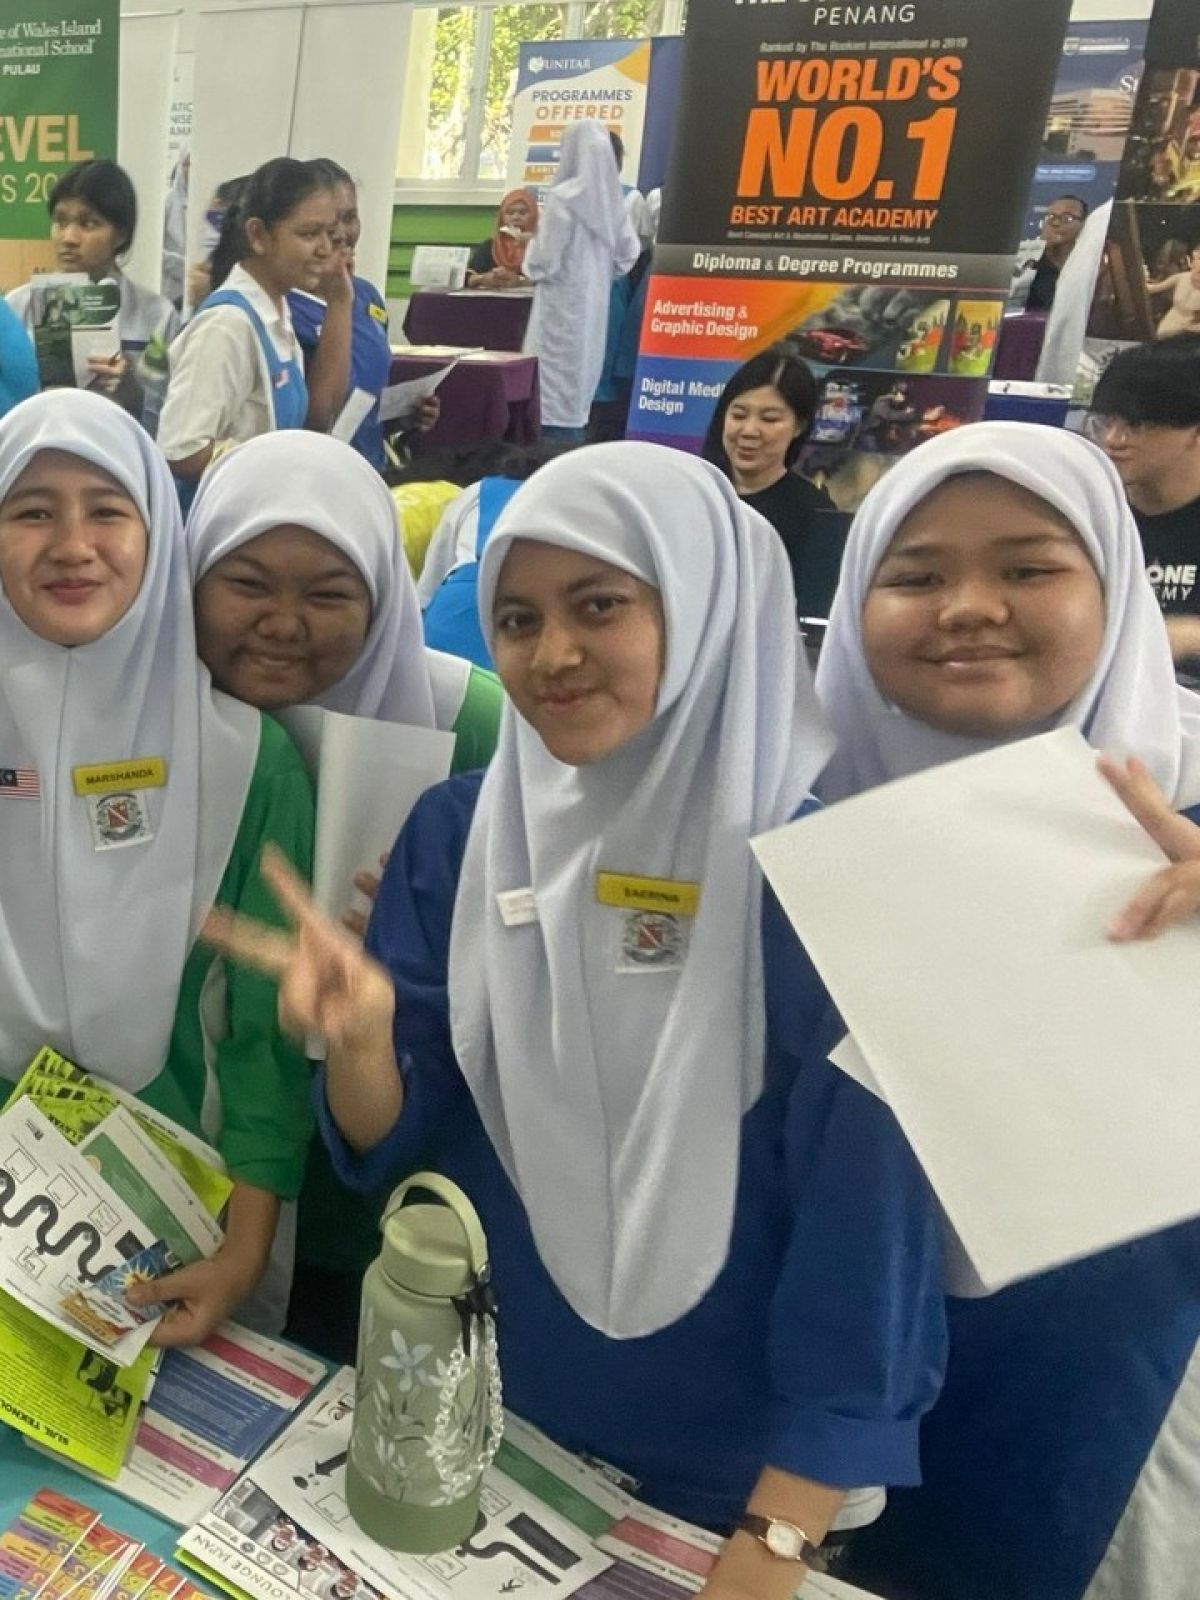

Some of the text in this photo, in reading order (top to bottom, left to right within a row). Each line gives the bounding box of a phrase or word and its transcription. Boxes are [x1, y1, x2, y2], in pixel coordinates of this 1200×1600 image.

[813, 5, 916, 26] PENANG
[7, 23, 21, 38] of
[22, 22, 59, 37] Wales
[61, 18, 101, 36] Island
[51, 38, 93, 55] School
[3, 64, 41, 76] PULAU
[757, 56, 962, 102] WORLD'S
[533, 89, 633, 101] PROGRAMMES
[536, 105, 625, 120] OFFERED
[736, 106, 958, 200] NO.1
[730, 205, 938, 230] BEST ART ACADEMY
[692, 252, 959, 279] Diploma & Degree Programmes
[653, 299, 748, 321] Advertising &
[651, 318, 759, 341] Graphic Design
[641, 377, 726, 396] Digital Medi
[639, 395, 684, 415] Design
[1147, 564, 1198, 585] ONE
